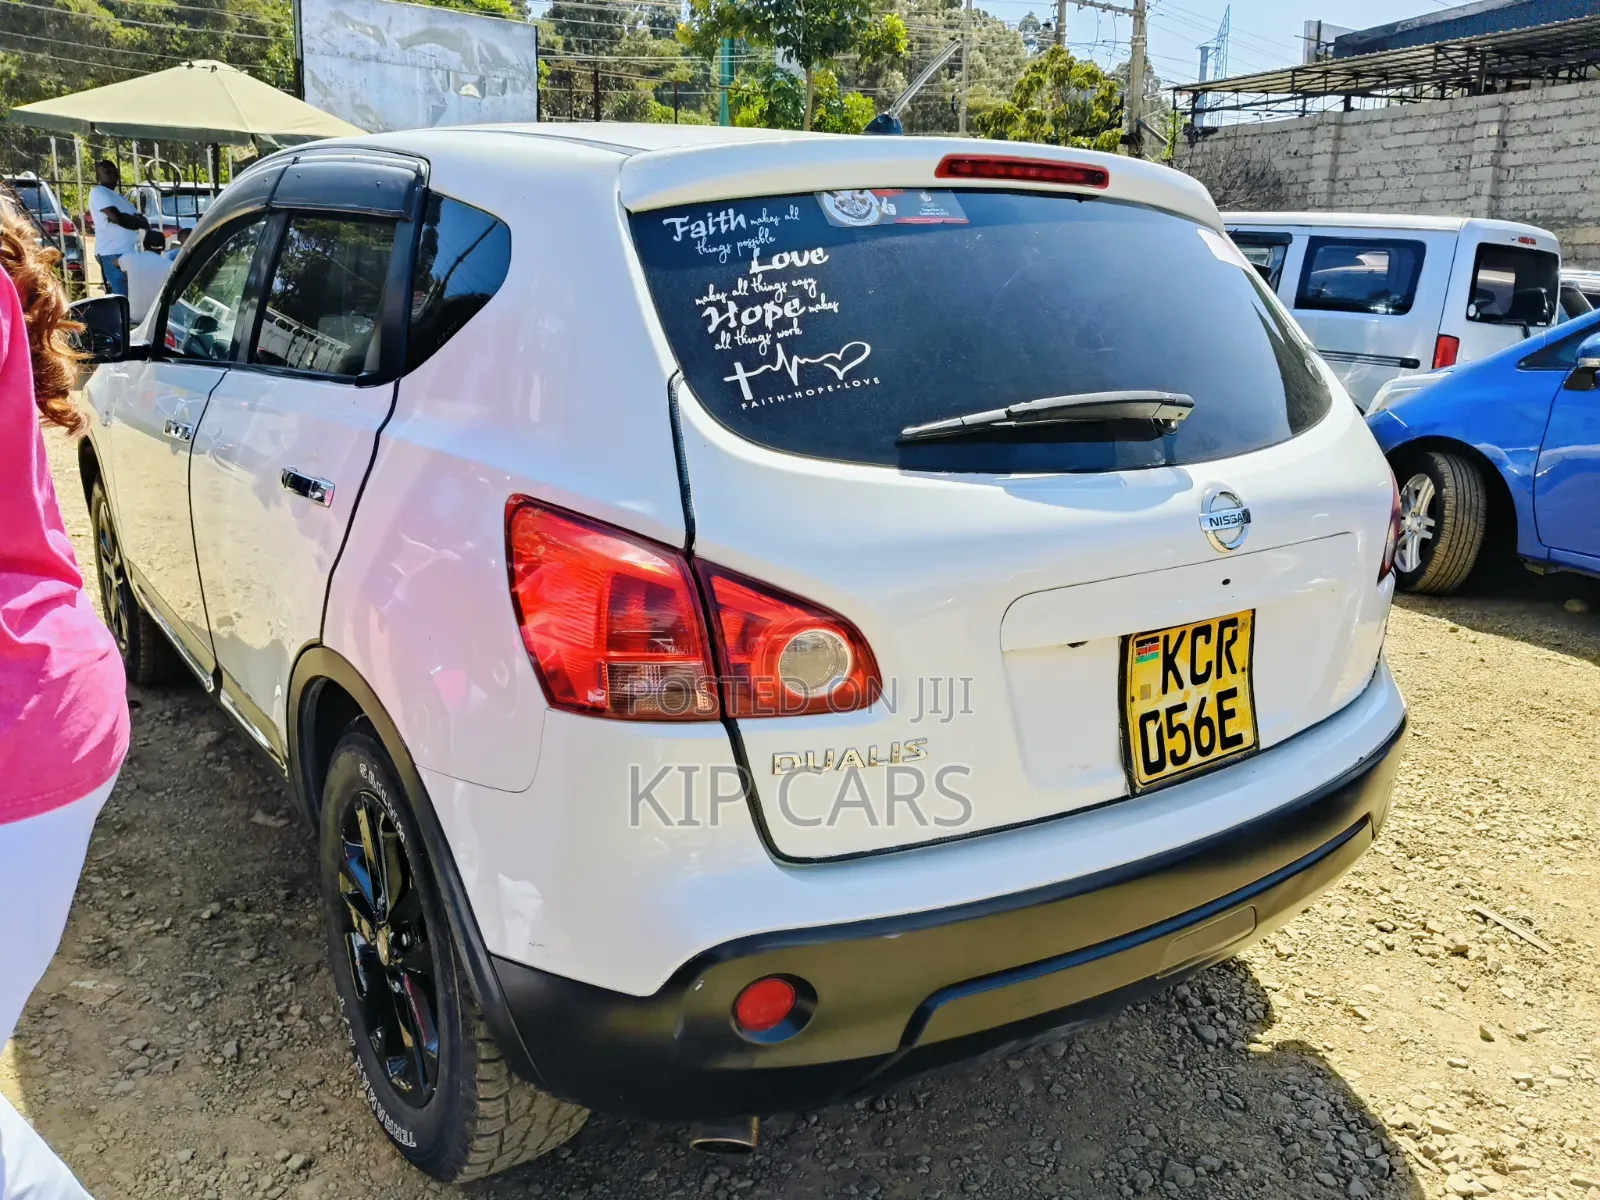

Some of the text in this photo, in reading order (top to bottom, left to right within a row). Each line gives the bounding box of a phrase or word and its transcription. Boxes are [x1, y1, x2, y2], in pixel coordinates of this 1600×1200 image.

[663, 205, 800, 242] Faith makes all
[695, 227, 776, 264] things possible
[749, 247, 830, 275] Love
[695, 274, 817, 306] makes all things easy
[701, 293, 839, 334] Hope makes
[714, 317, 803, 356] all things work
[741, 376, 881, 410] FAITH HOPE LOVE
[1209, 507, 1250, 527] NISSAN
[1161, 616, 1239, 696] KCR
[1138, 686, 1244, 777] 056E
[772, 737, 928, 776] DUALIS
